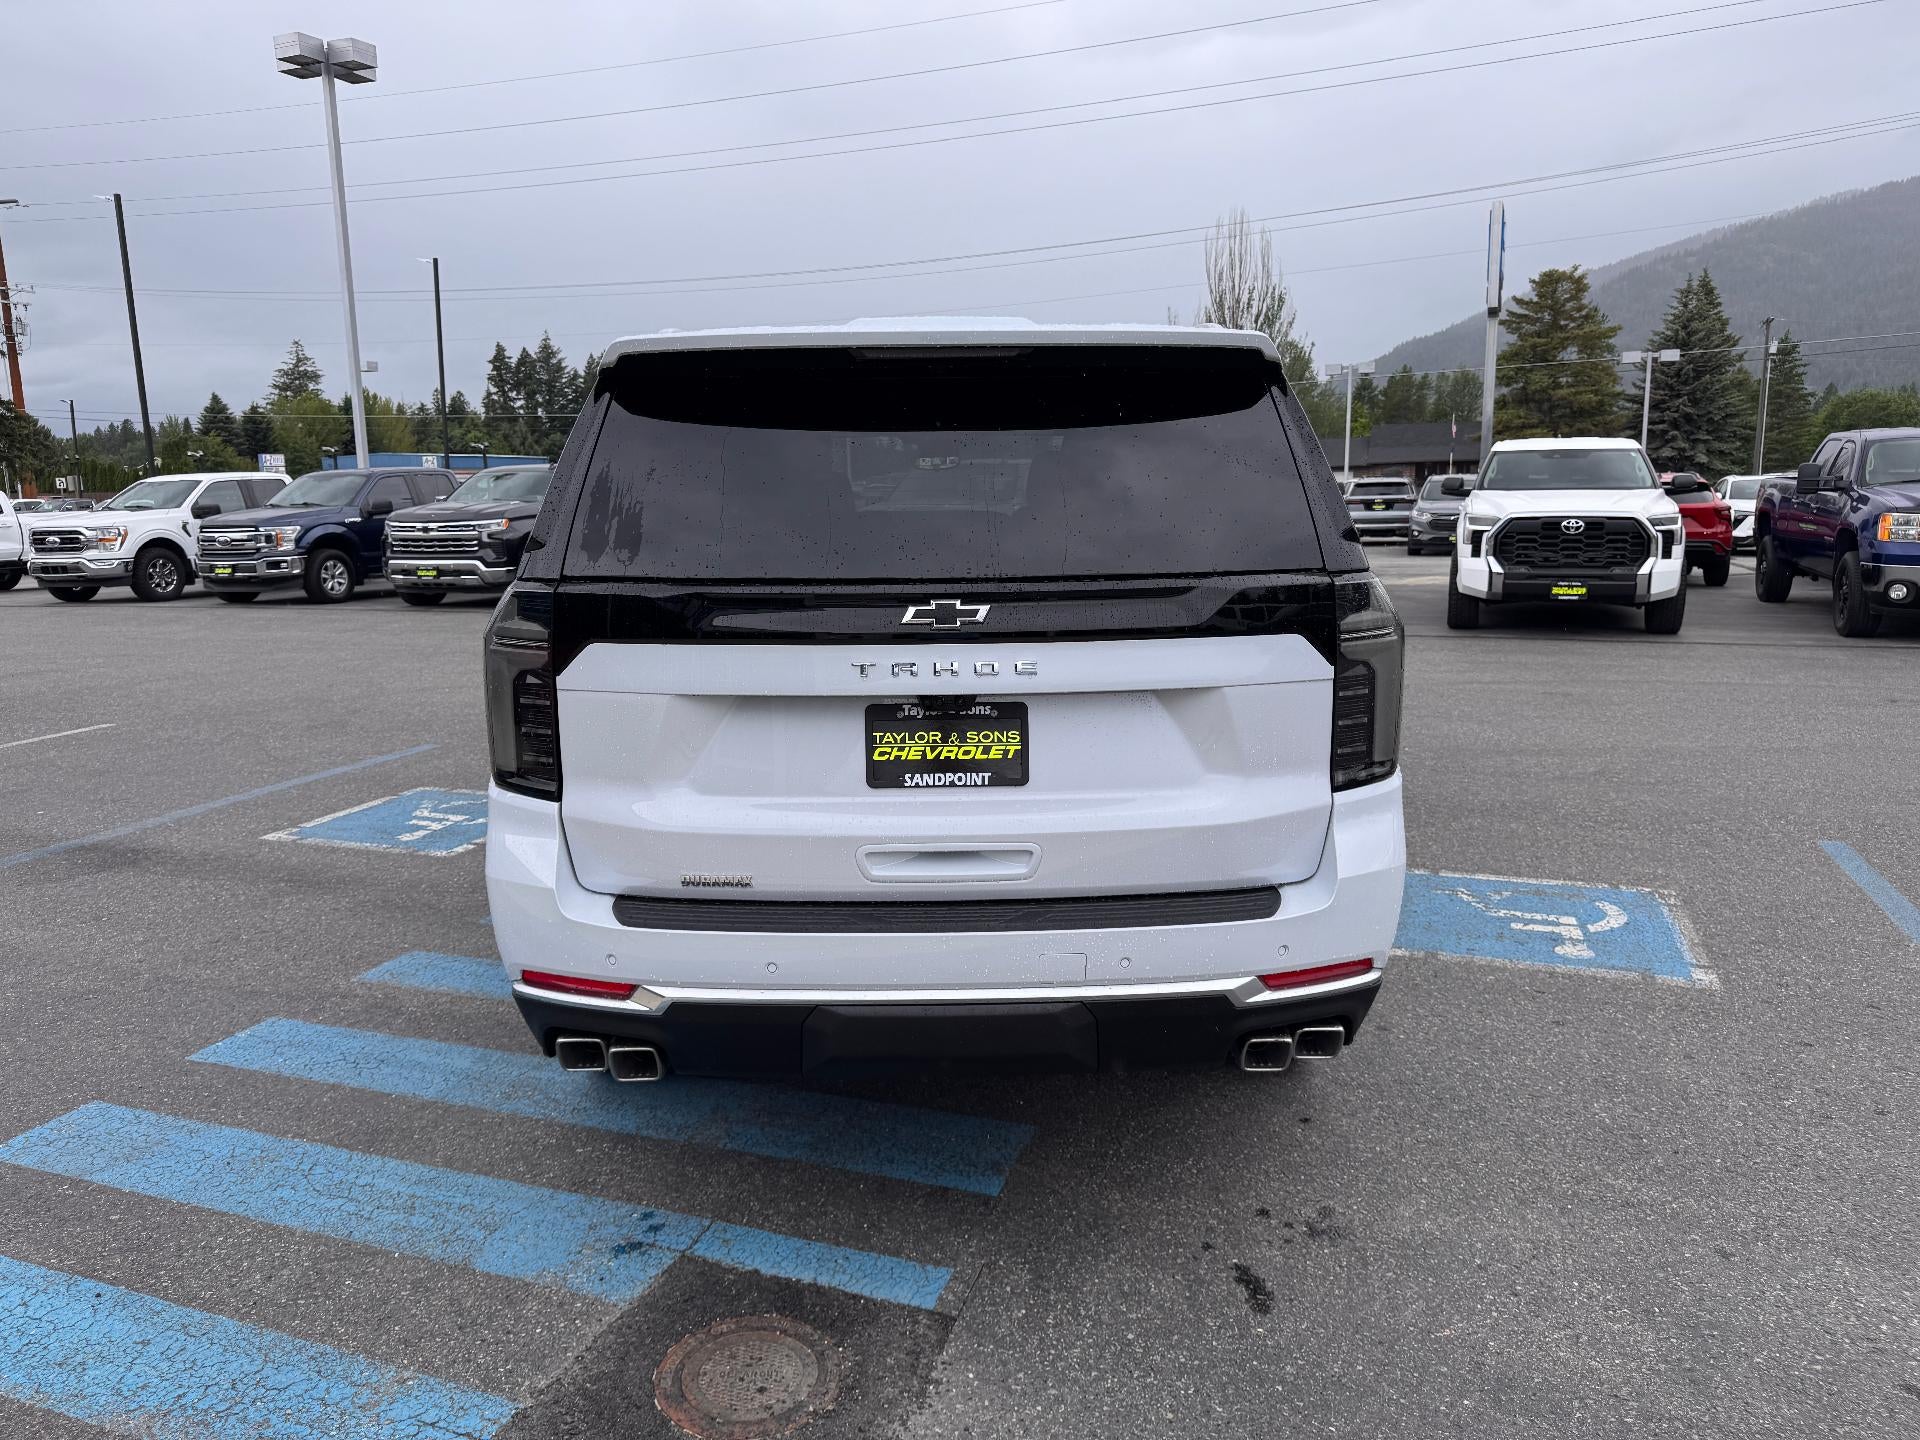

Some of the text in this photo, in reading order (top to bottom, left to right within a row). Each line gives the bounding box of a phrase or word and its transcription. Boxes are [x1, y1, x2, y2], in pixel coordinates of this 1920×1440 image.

[851, 661, 1037, 678] TAHOE
[872, 730, 1021, 746] TAYLOR & SONS
[872, 745, 1021, 761] CHEVROLET
[903, 772, 992, 787] SANDPOINT
[681, 875, 753, 887] DURAMAX
